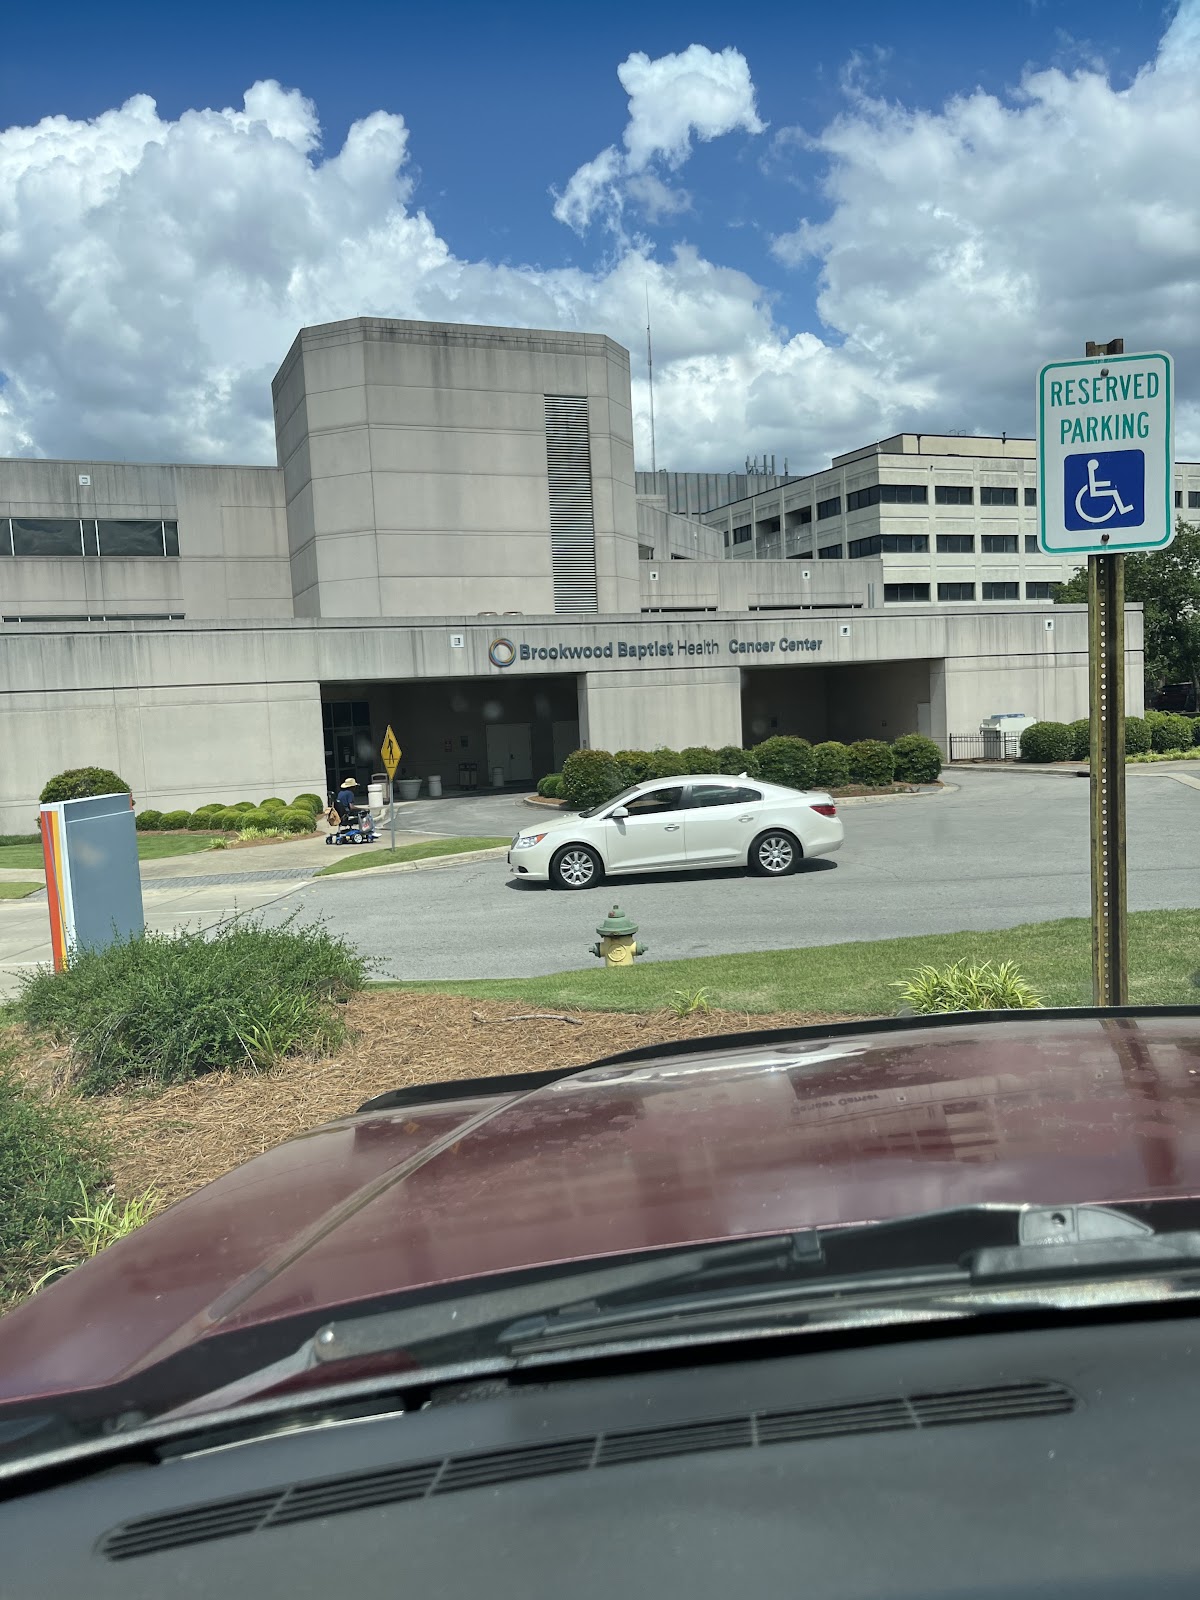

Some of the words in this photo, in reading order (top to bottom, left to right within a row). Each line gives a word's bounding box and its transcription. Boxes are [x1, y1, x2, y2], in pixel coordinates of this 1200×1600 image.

[1051, 372, 1159, 407] RESERVED
[1060, 411, 1149, 445] PARKING
[519, 642, 613, 661] Brookwood
[617, 640, 674, 660] Baptist
[677, 639, 719, 656] Health
[728, 638, 776, 654] Cancer
[779, 637, 823, 652] Center
